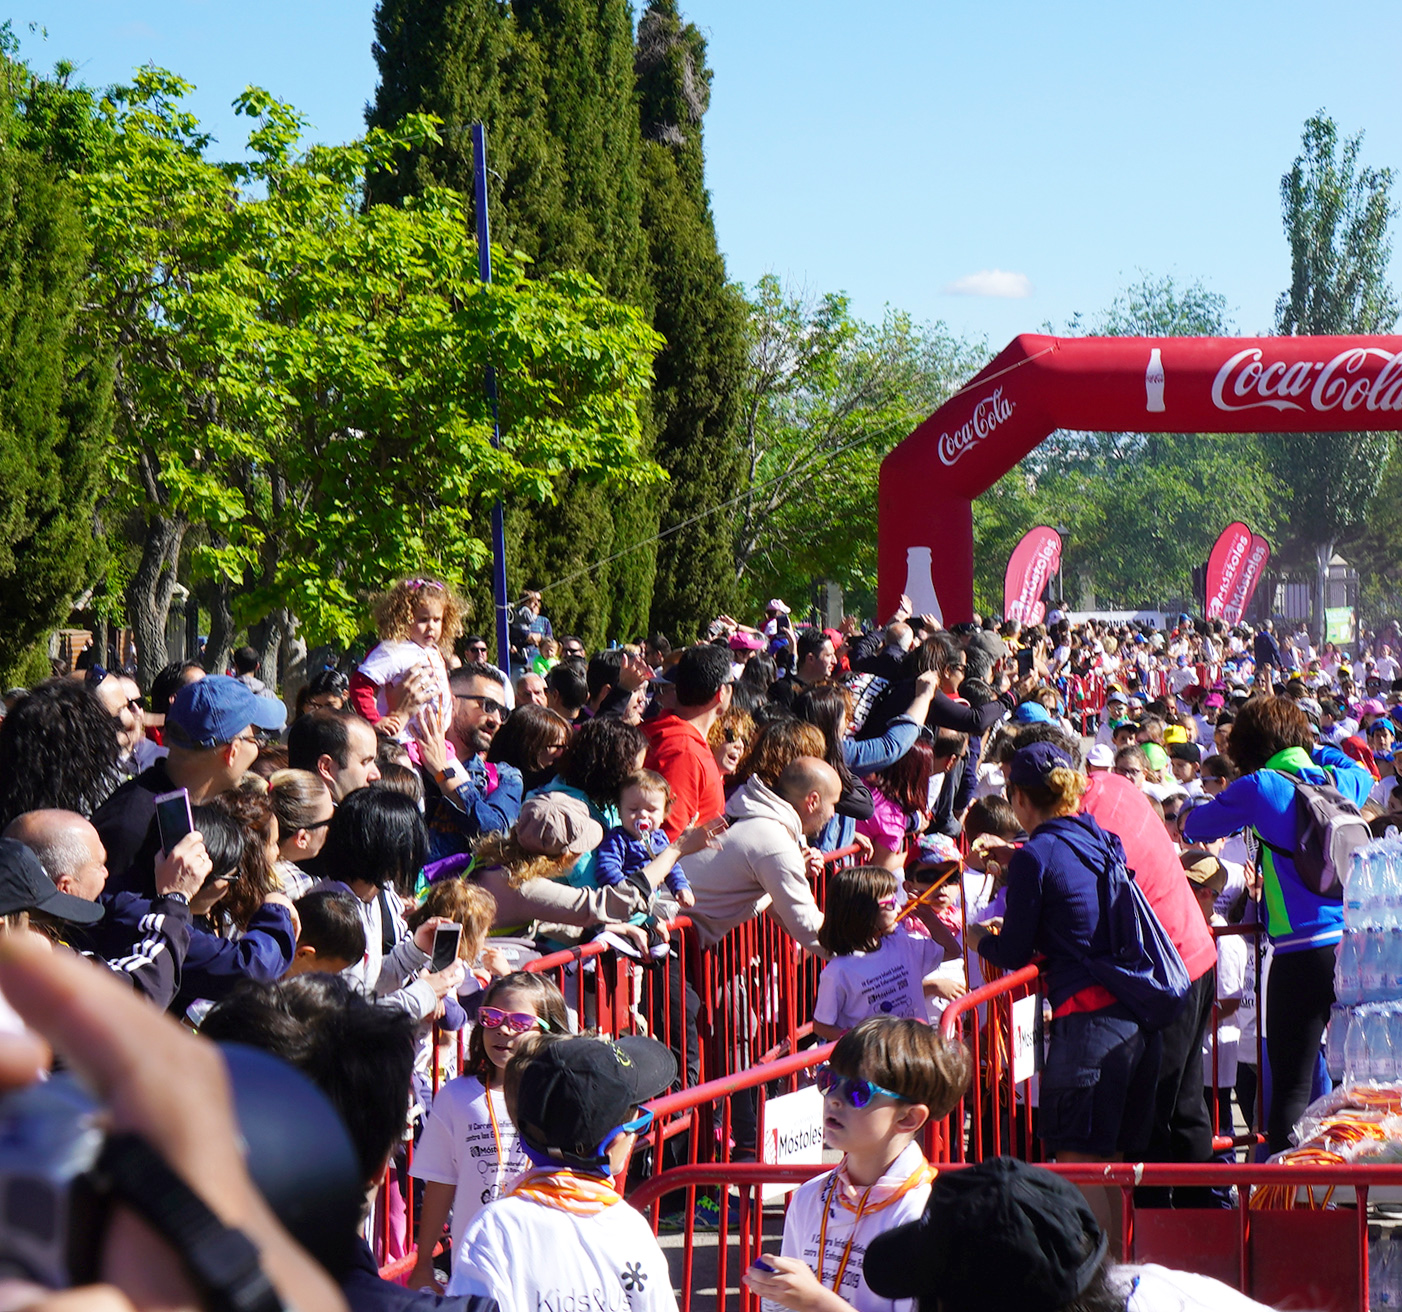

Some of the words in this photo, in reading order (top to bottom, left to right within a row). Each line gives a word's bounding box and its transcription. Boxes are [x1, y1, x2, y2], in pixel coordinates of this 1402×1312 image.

[938, 385, 1015, 466] Coca-Cola
[1231, 545, 1266, 609] Móstoles
[779, 1123, 823, 1158] Móstoles
